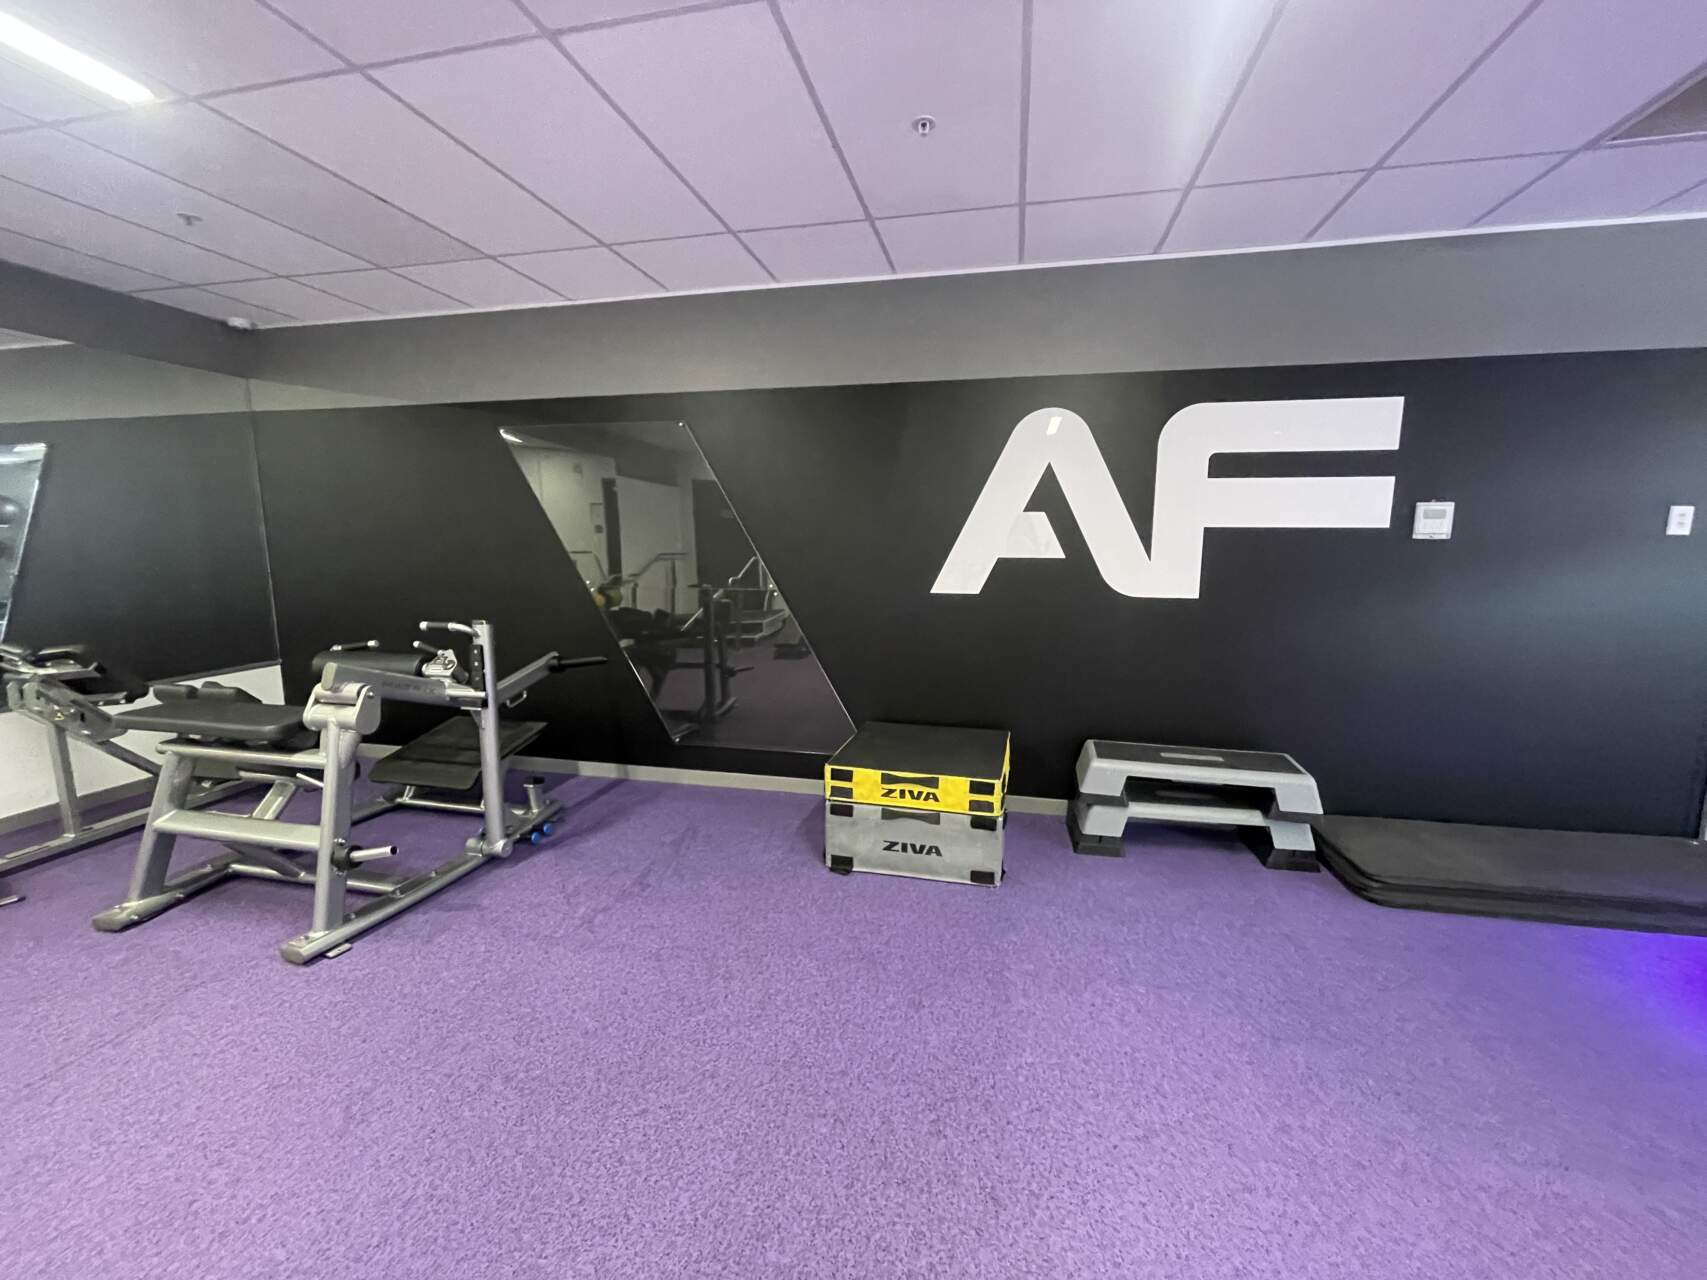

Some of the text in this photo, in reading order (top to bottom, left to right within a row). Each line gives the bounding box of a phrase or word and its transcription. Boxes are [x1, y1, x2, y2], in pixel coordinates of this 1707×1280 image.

[930, 396, 1405, 599] AF
[880, 787, 941, 803] ZIVA
[882, 840, 943, 857] ZIVA
